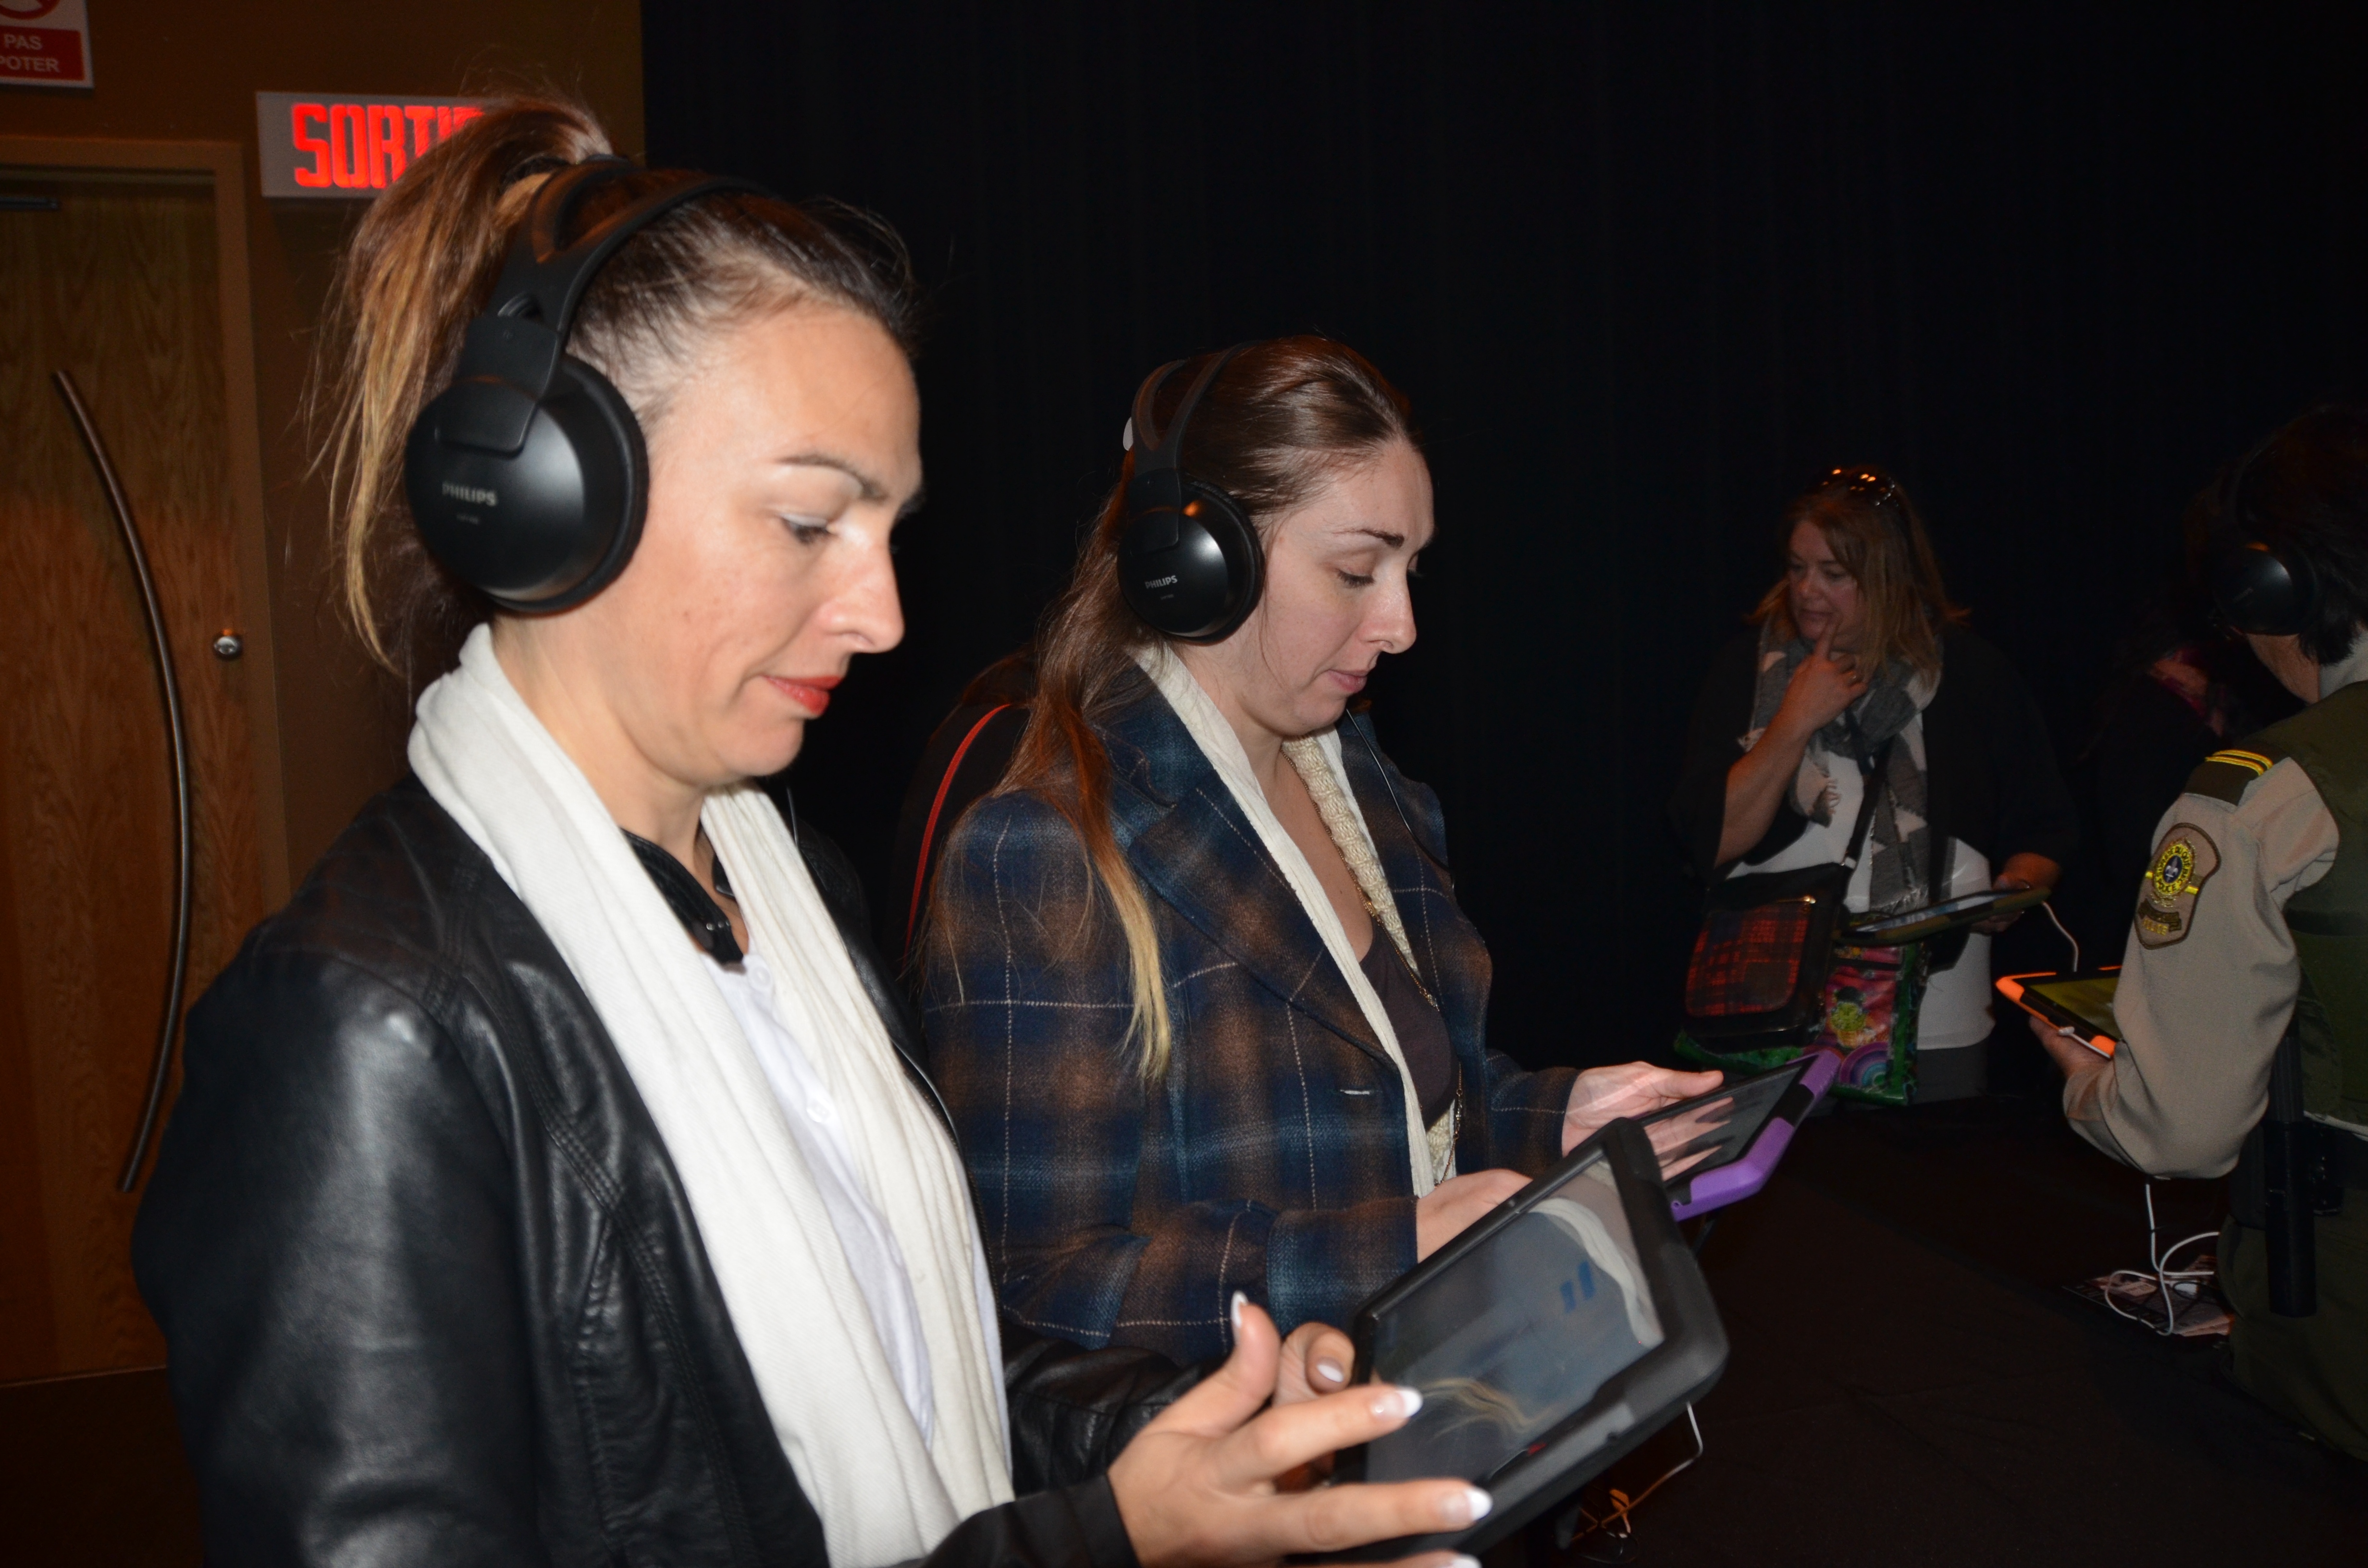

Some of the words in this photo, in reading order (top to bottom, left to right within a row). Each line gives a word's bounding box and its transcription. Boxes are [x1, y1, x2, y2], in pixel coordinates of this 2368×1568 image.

[3, 33, 43, 50] PAS
[292, 103, 484, 189] SORT
[442, 481, 498, 506] PHILIPS
[1145, 575, 1177, 589] PHILIPS
